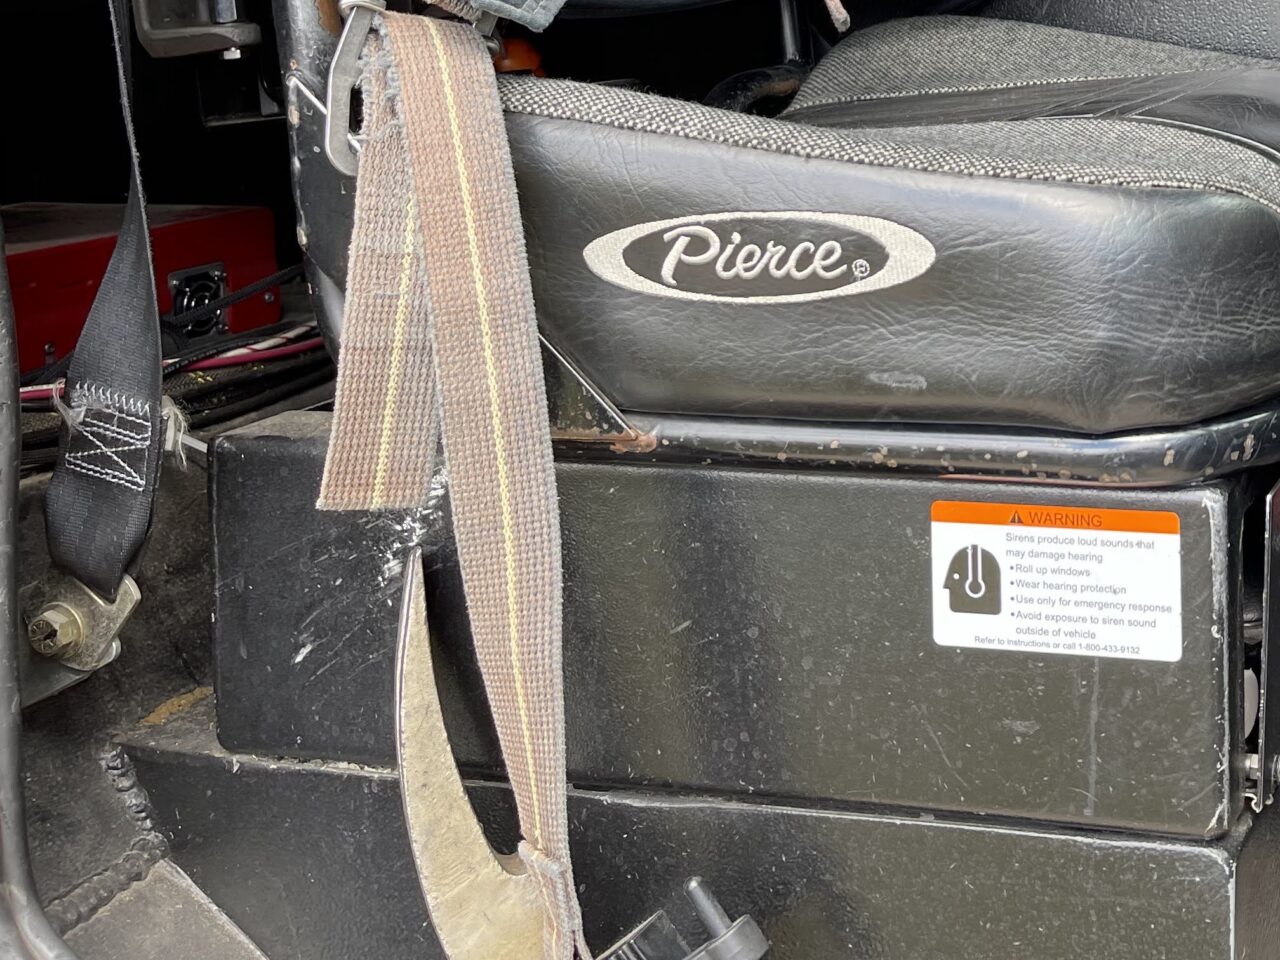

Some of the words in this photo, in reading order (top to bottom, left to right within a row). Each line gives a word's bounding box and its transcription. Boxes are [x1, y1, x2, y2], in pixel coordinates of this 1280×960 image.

[660, 224, 848, 286] Pierce
[1029, 511, 1103, 527] WARNING
[1005, 532, 1035, 543] Sirens
[1037, 535, 1075, 548] produce
[1077, 537, 1098, 547] loud
[1100, 538, 1134, 549] sounds
[1005, 548, 1026, 559] may
[1028, 548, 1065, 562] damage
[1068, 551, 1103, 564] hearing
[1015, 564, 1033, 574] Roll
[1036, 567, 1048, 577] up
[1050, 566, 1091, 577] windows
[1015, 579, 1040, 590] Wear
[1043, 579, 1077, 593] hearing
[1080, 582, 1127, 596] protection
[1015, 594, 1034, 605] Use
[1037, 596, 1056, 608] only
[1058, 596, 1071, 607] for
[1074, 599, 1126, 612] emergency
[1128, 603, 1172, 615] response
[1015, 610, 1042, 621] Avoid
[1044, 613, 1087, 625] exposure
[1090, 615, 1099, 625] to
[1101, 615, 1125, 626] siren
[1127, 617, 1157, 628] sound
[1015, 626, 1050, 637] outside
[1052, 627, 1061, 637] of
[1063, 628, 1096, 640] vehicle
[974, 635, 995, 645] Refer
[997, 637, 1005, 646] to
[1007, 638, 1051, 649] instructions
[1052, 641, 1060, 650] or
[1062, 641, 1076, 651] call
[1079, 642, 1141, 655] 1-800-433-9132
